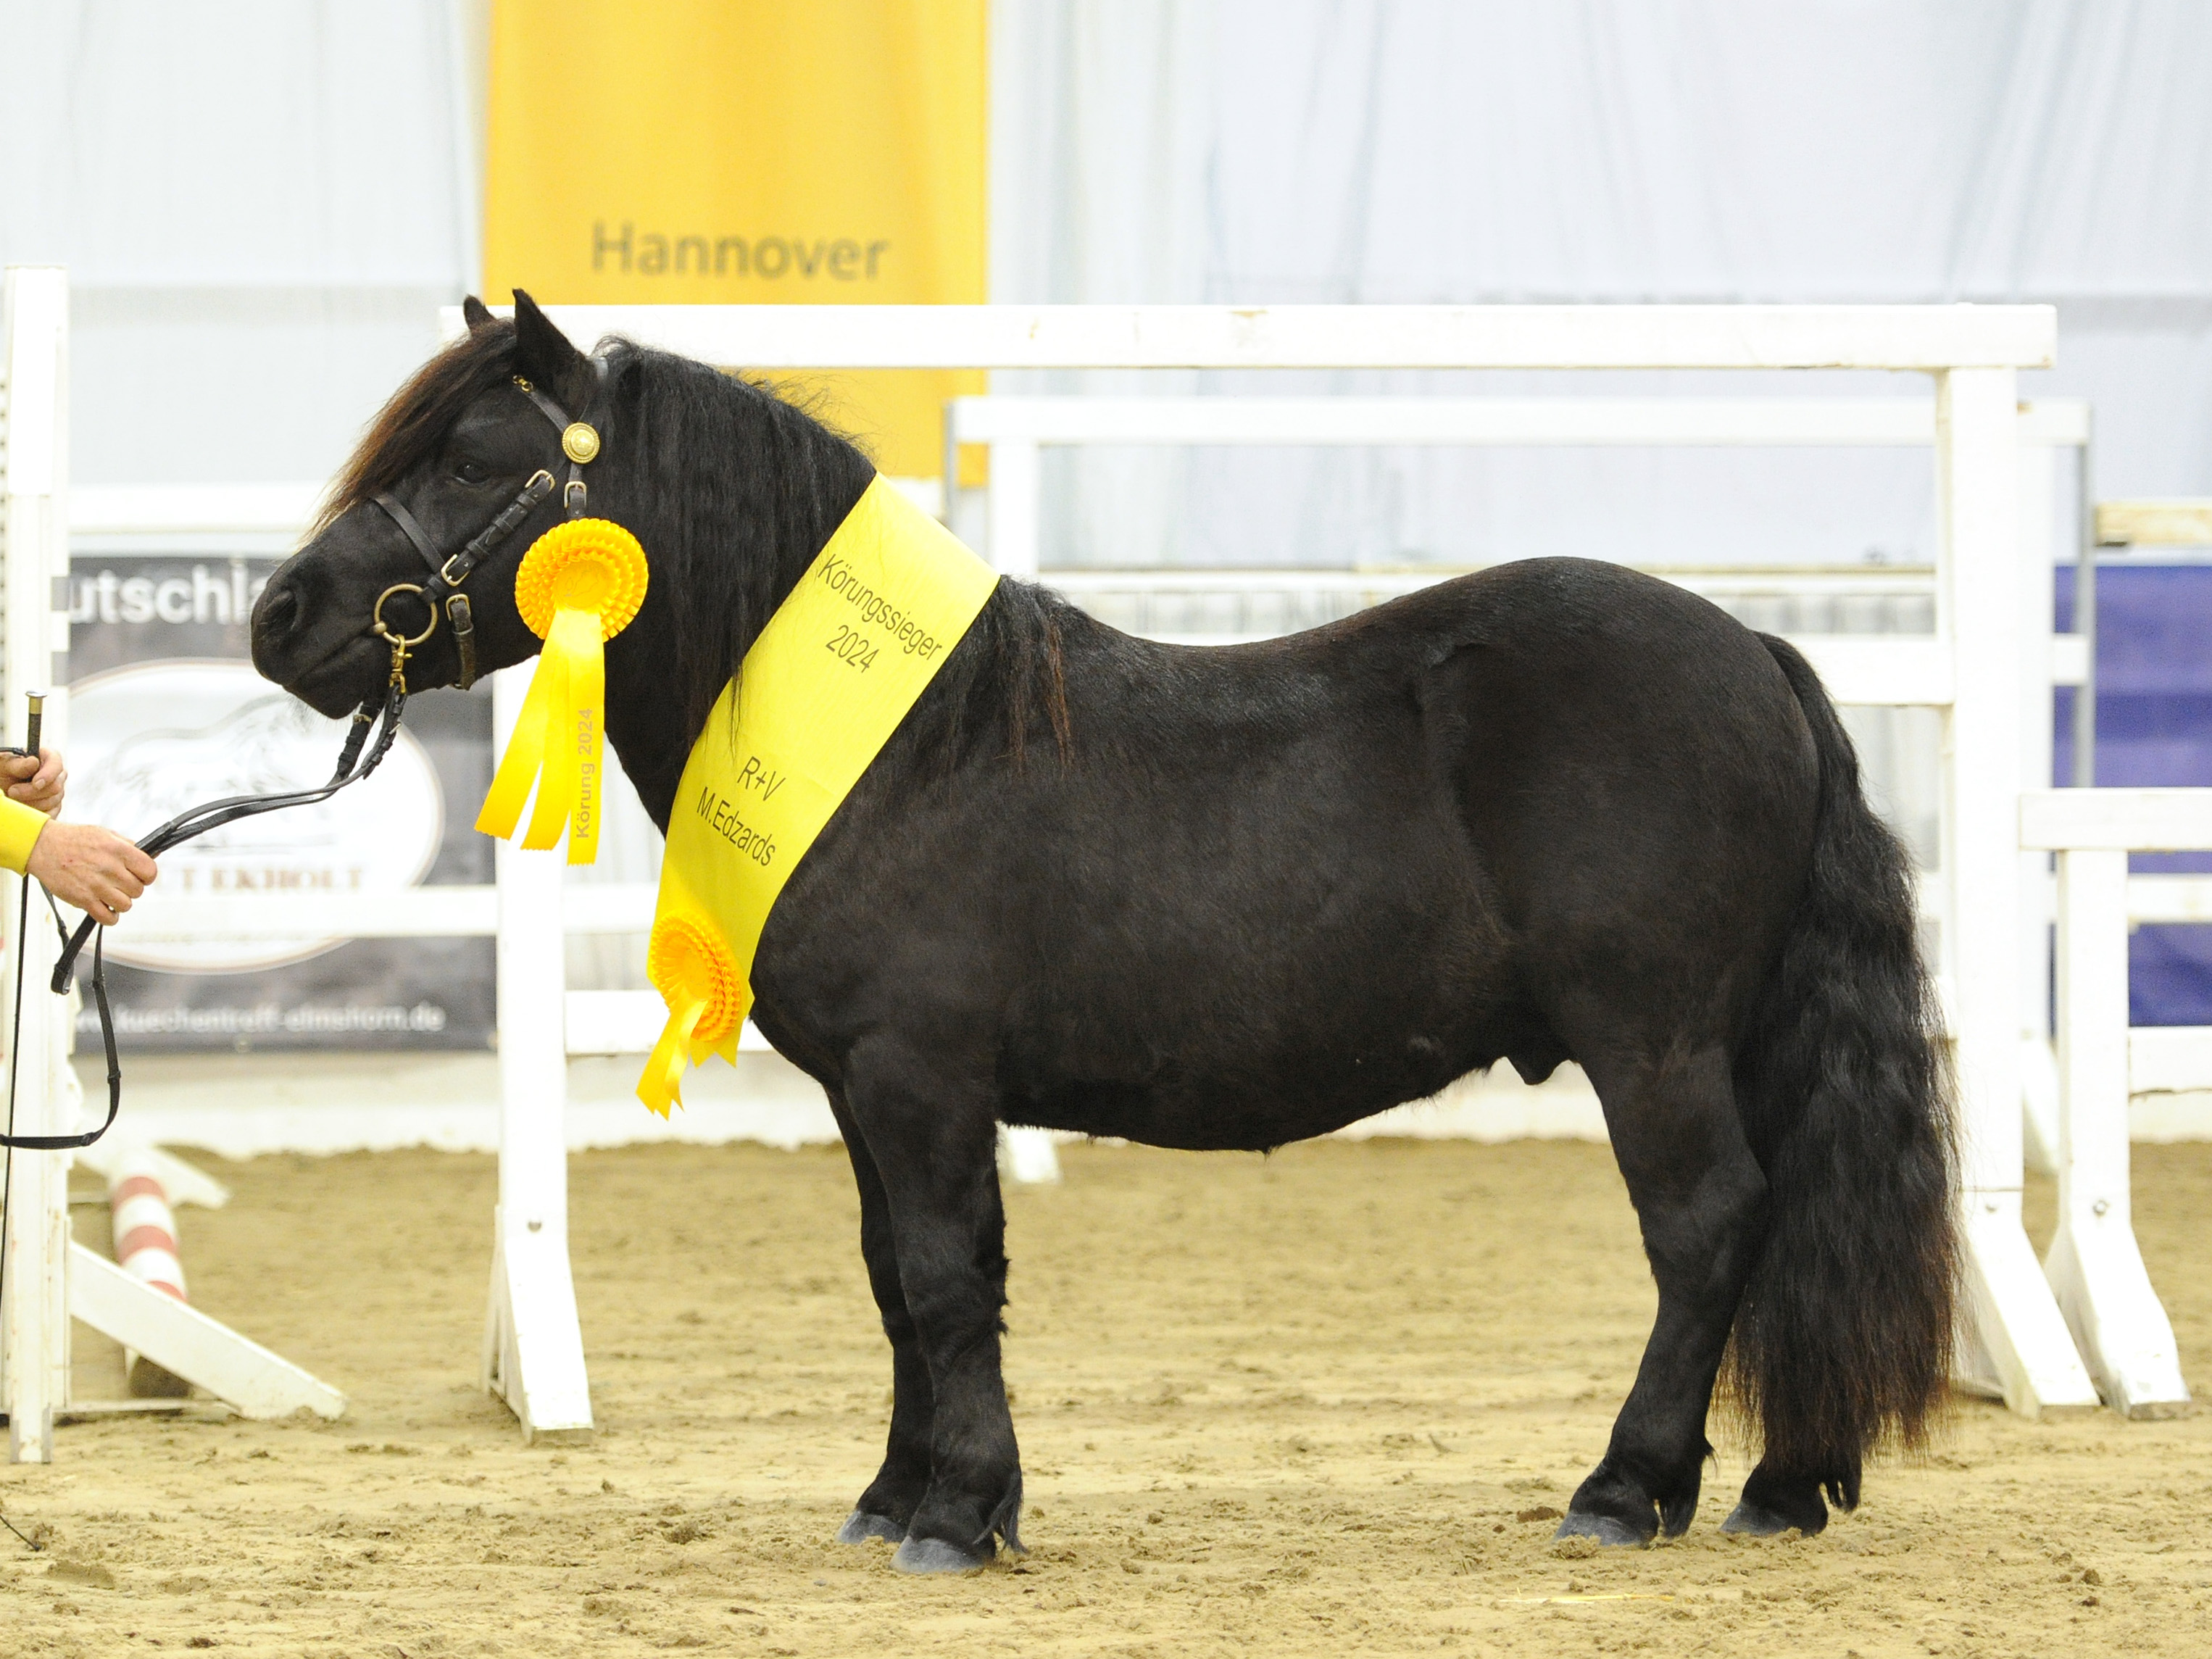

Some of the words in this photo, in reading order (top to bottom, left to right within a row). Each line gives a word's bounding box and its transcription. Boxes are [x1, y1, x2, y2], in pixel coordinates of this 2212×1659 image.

[591, 219, 890, 280] Hannover
[818, 554, 942, 660] Körungssieger
[826, 624, 880, 673] 2024
[578, 708, 593, 756] 2024
[576, 763, 595, 838] Körung
[736, 756, 786, 802] R+V
[697, 786, 776, 866] M.Edzards
